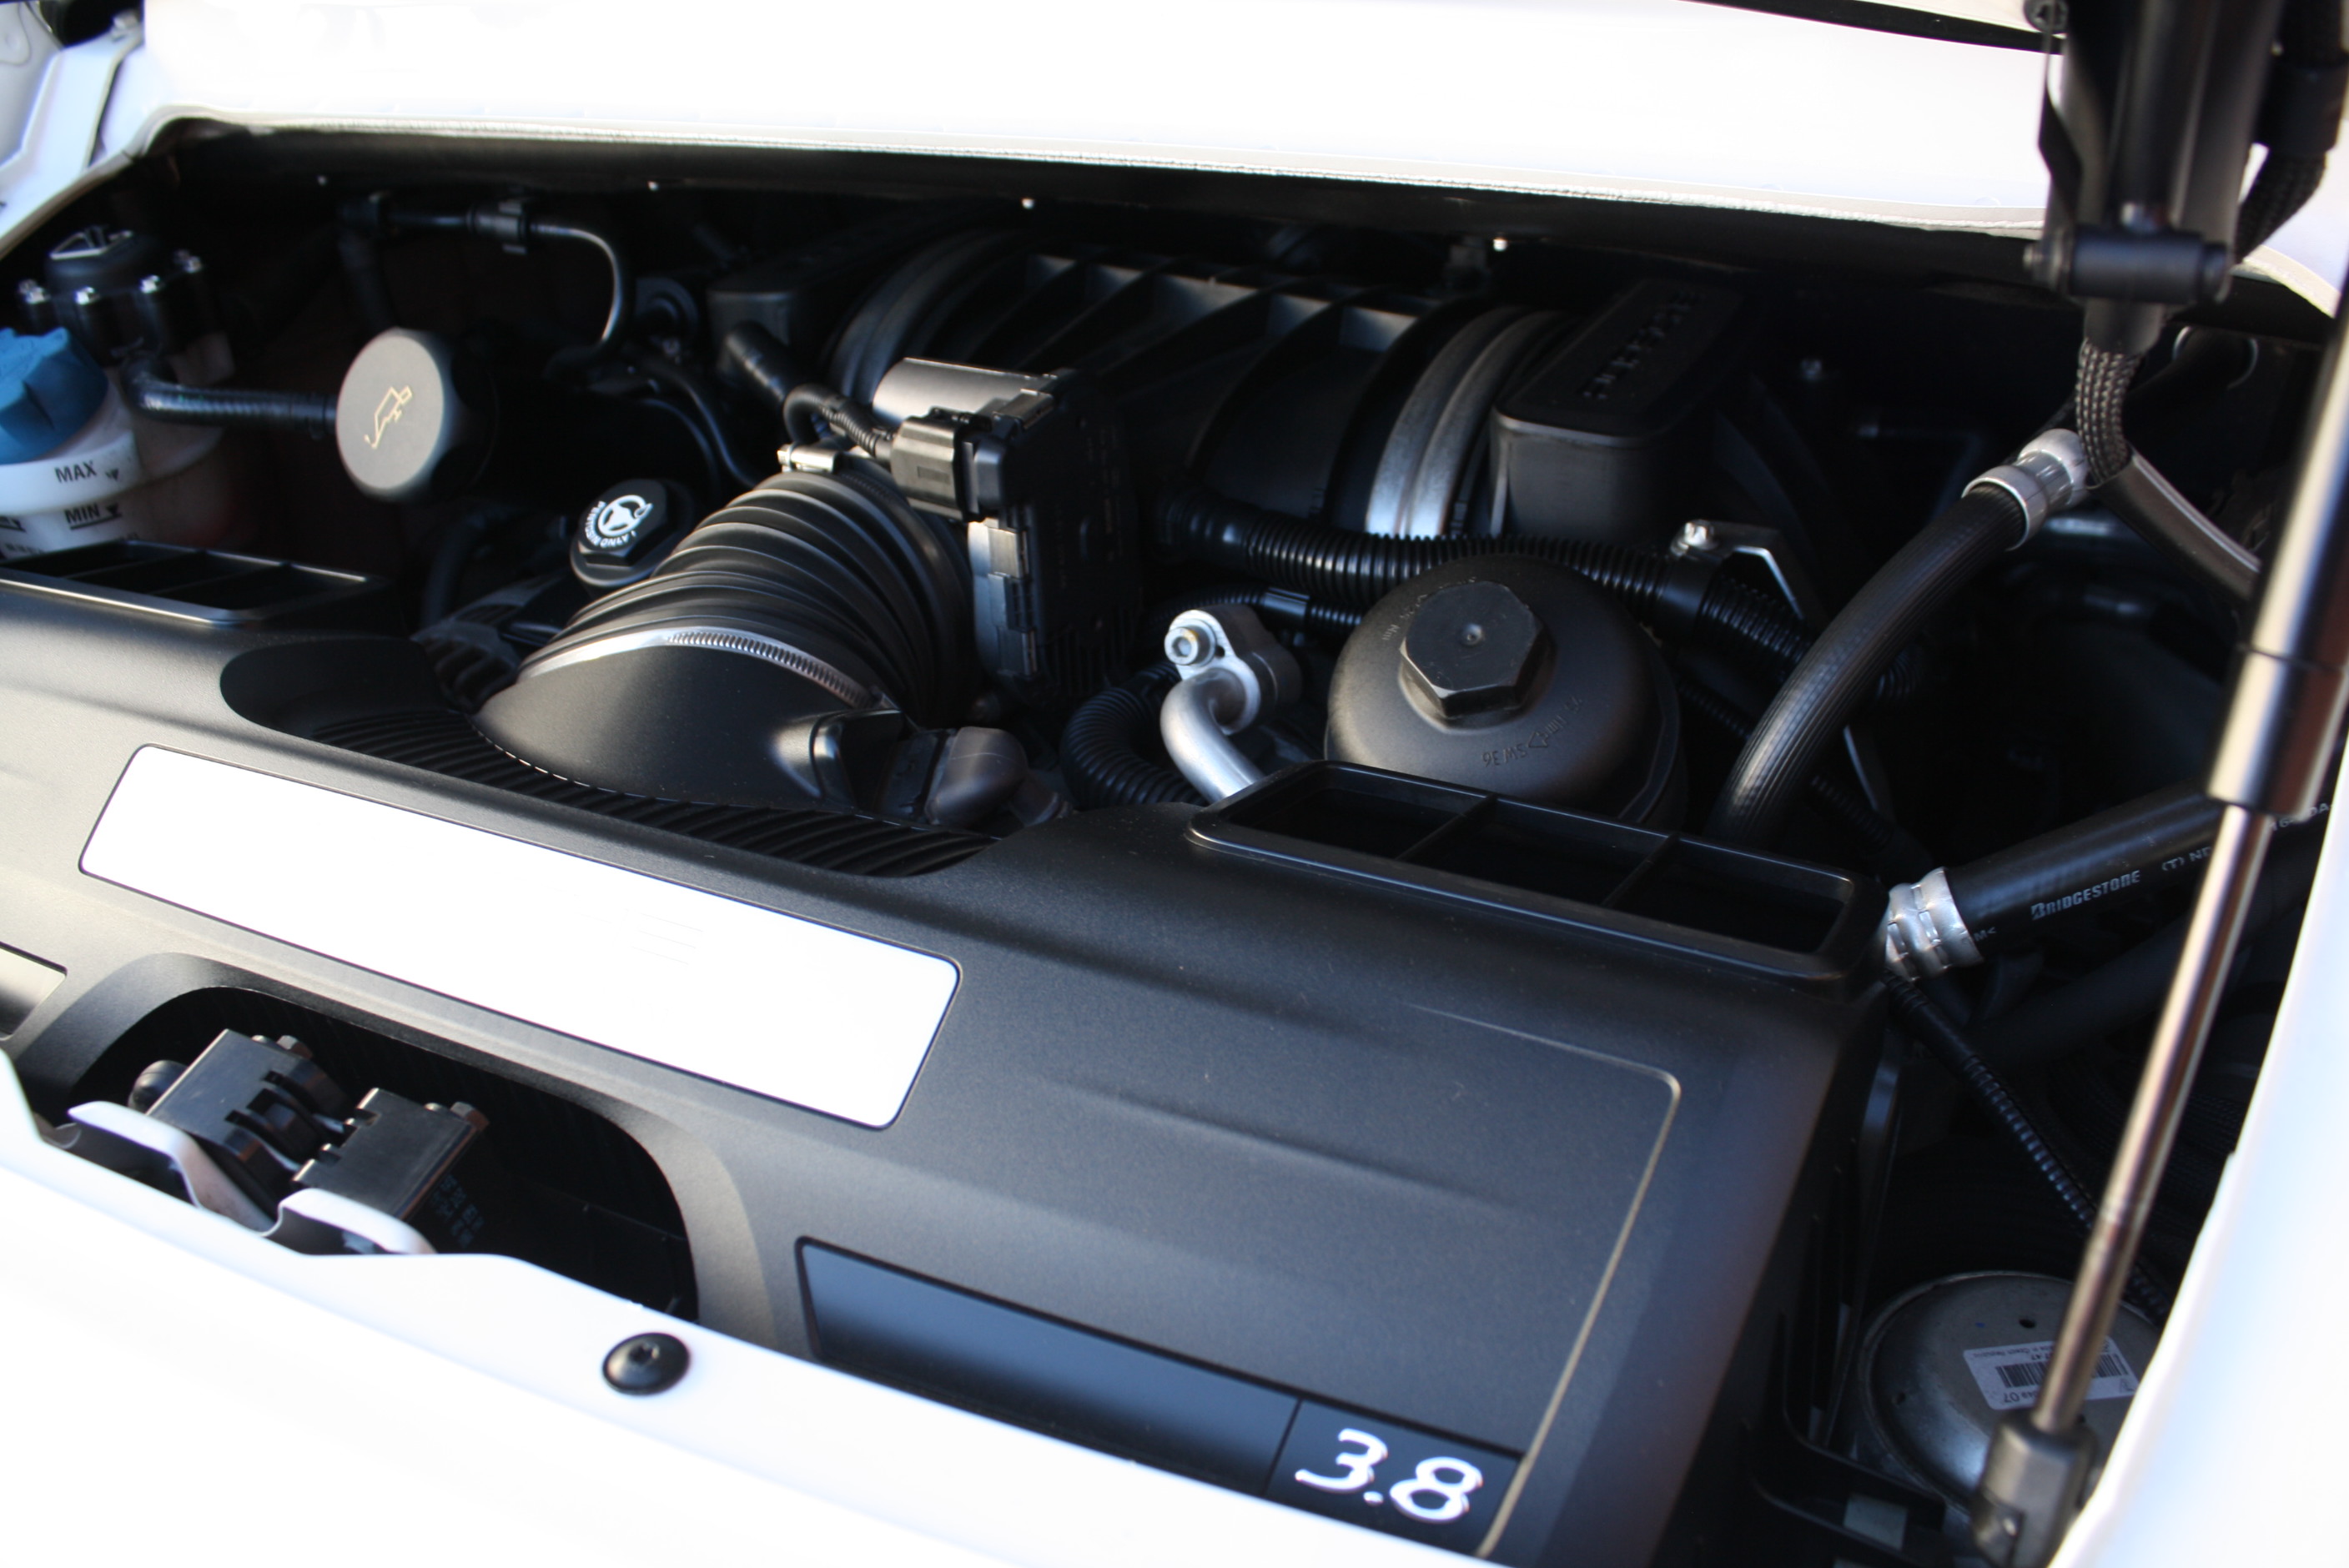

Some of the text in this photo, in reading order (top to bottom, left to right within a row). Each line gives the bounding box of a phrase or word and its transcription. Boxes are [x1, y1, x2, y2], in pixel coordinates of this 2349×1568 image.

[54, 460, 98, 483] MAX
[64, 503, 101, 524] MIN
[600, 534, 630, 548] ONLY
[2030, 870, 2141, 921] BRIDGESTONE
[1295, 1427, 1483, 1523] 3.8
